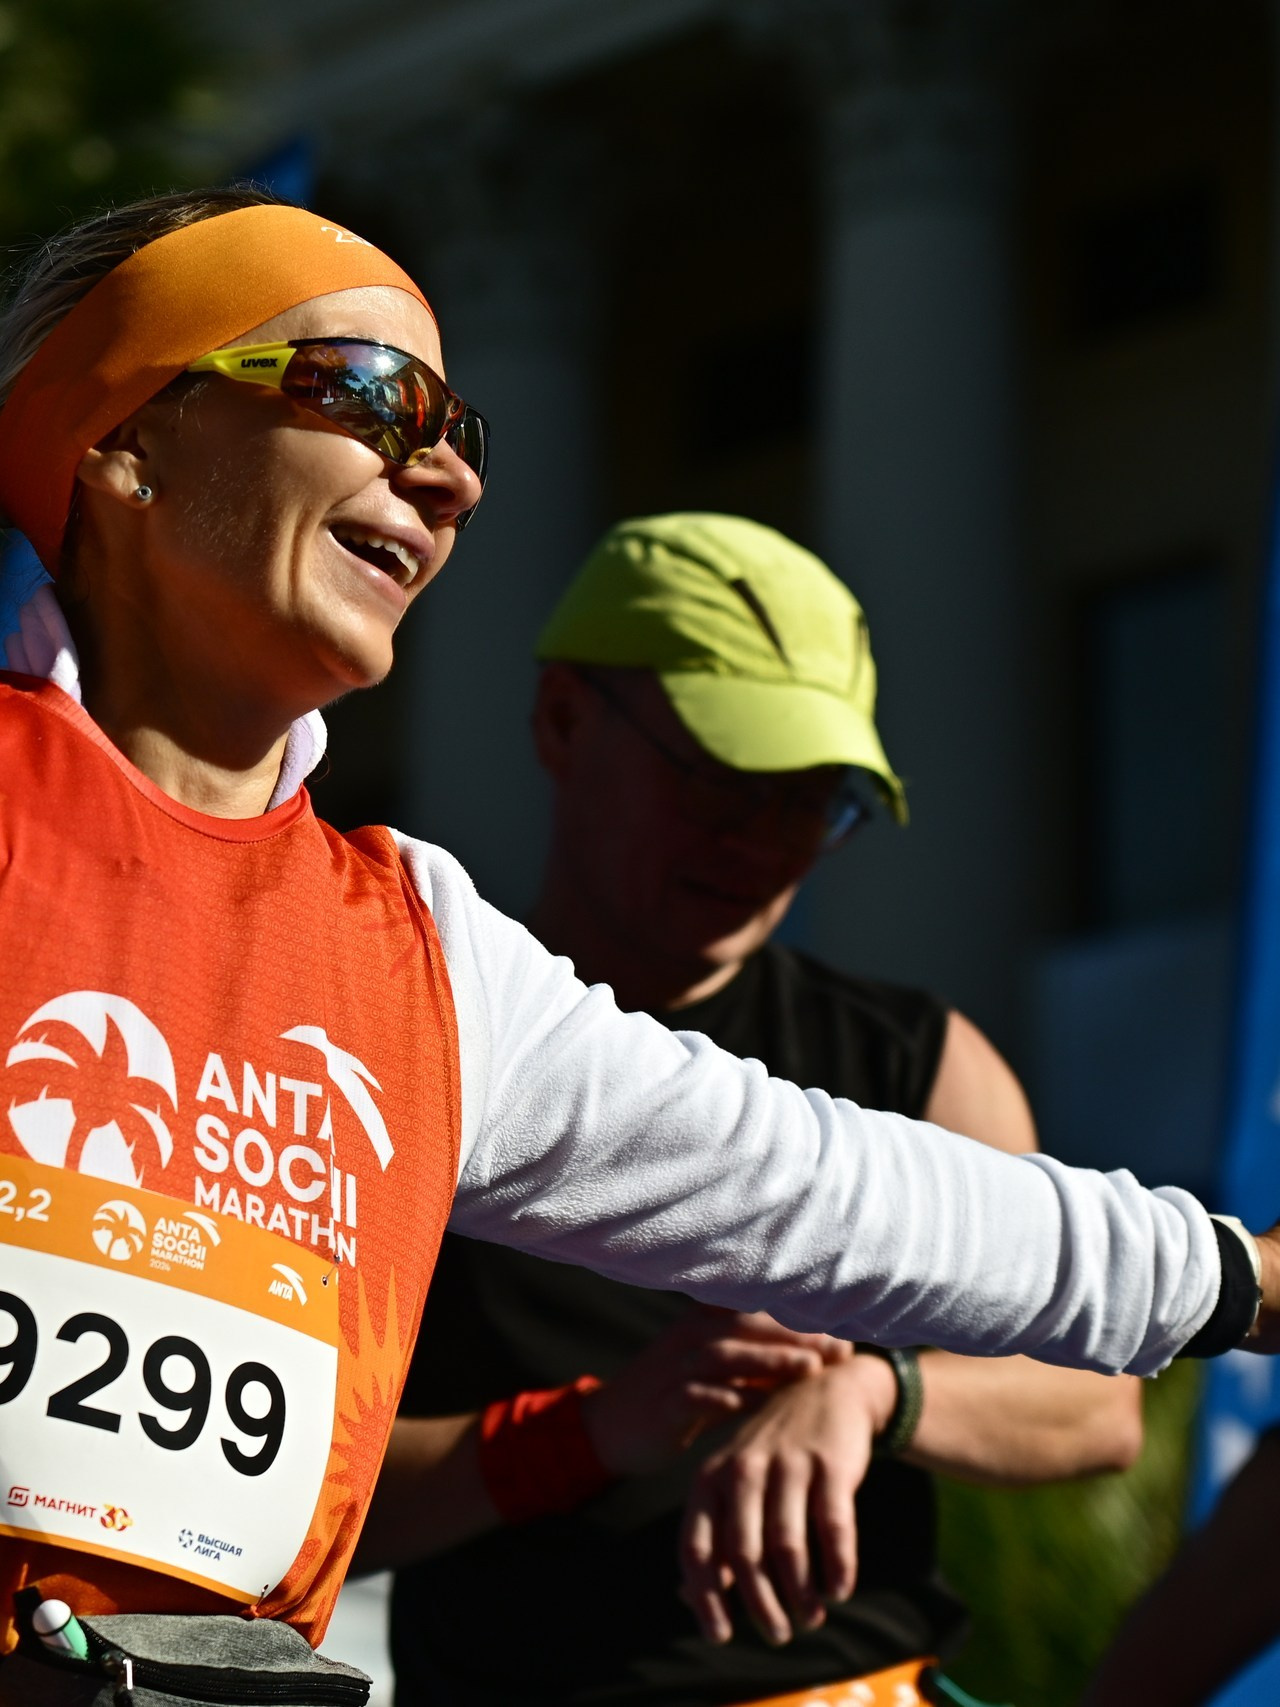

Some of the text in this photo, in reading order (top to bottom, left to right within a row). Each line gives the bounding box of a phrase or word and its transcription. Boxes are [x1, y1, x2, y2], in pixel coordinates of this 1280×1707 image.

[241, 358, 278, 368] uvex
[154, 1217, 201, 1243] ANTA
[194, 1176, 357, 1268] MARATHN
[152, 1232, 207, 1261] SOCHI
[150, 1248, 205, 1271] MARATHON
[267, 1279, 294, 1302] ANTA
[34, 1494, 97, 1518] МАГНИТ
[194, 1545, 221, 1561] ЛИГА
[197, 1533, 243, 1557] ВЫСШАЯ
